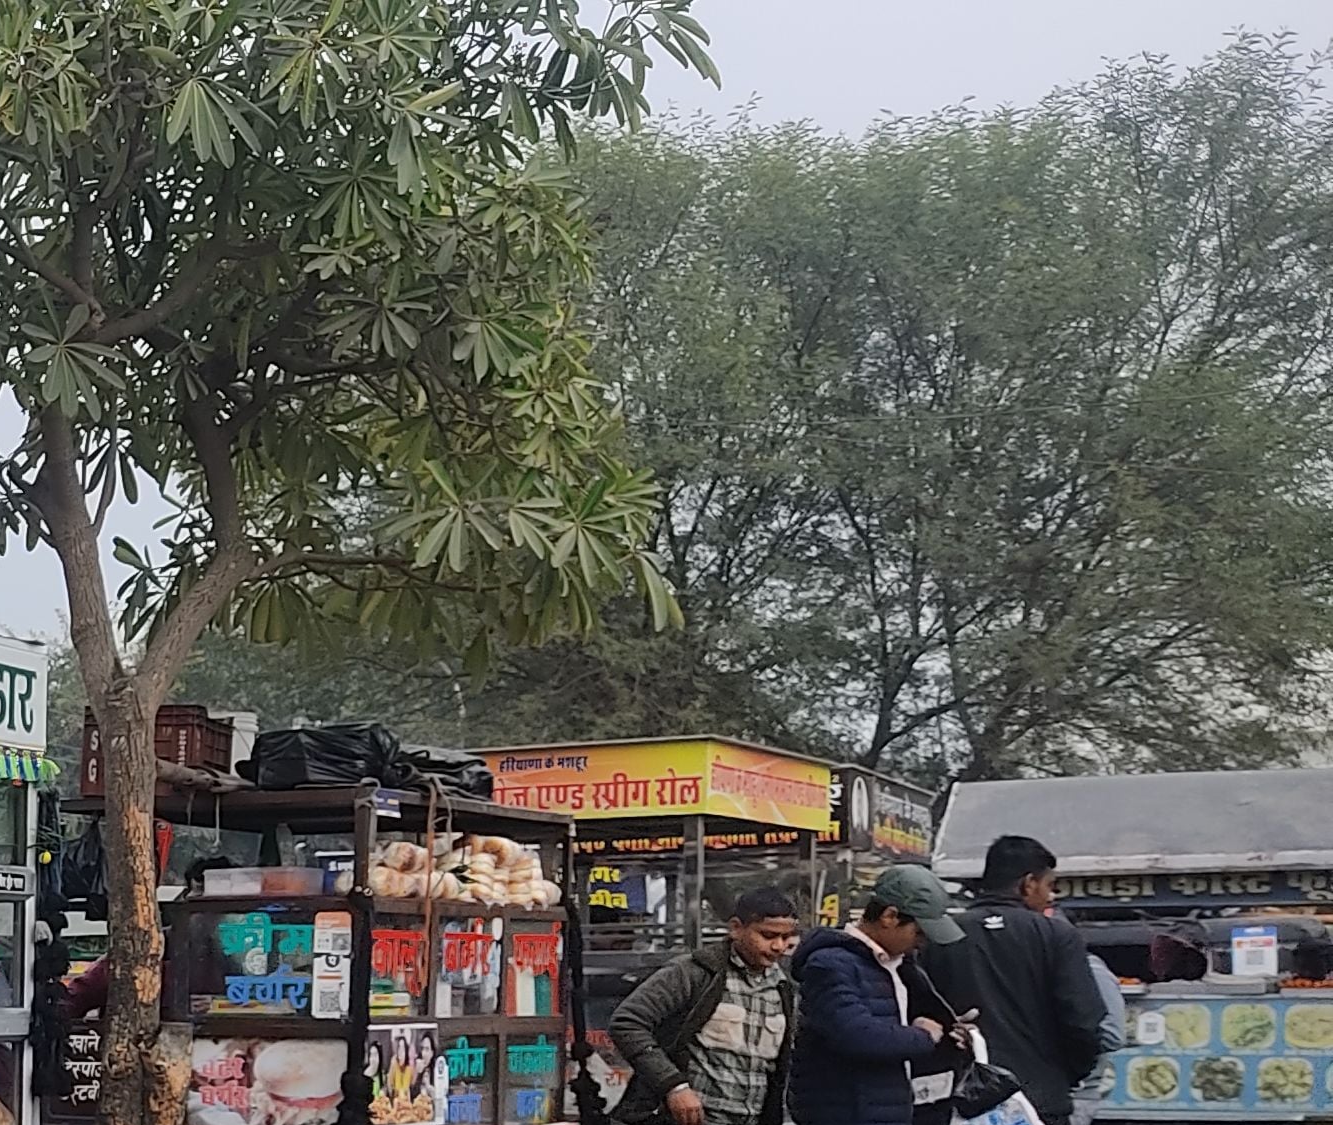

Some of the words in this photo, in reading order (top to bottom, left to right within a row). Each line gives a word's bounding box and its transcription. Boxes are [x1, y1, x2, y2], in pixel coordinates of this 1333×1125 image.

[499, 756, 542, 772] हरियाणा
[536, 784, 586, 810] एण्ड
[655, 768, 703, 805] रोल
